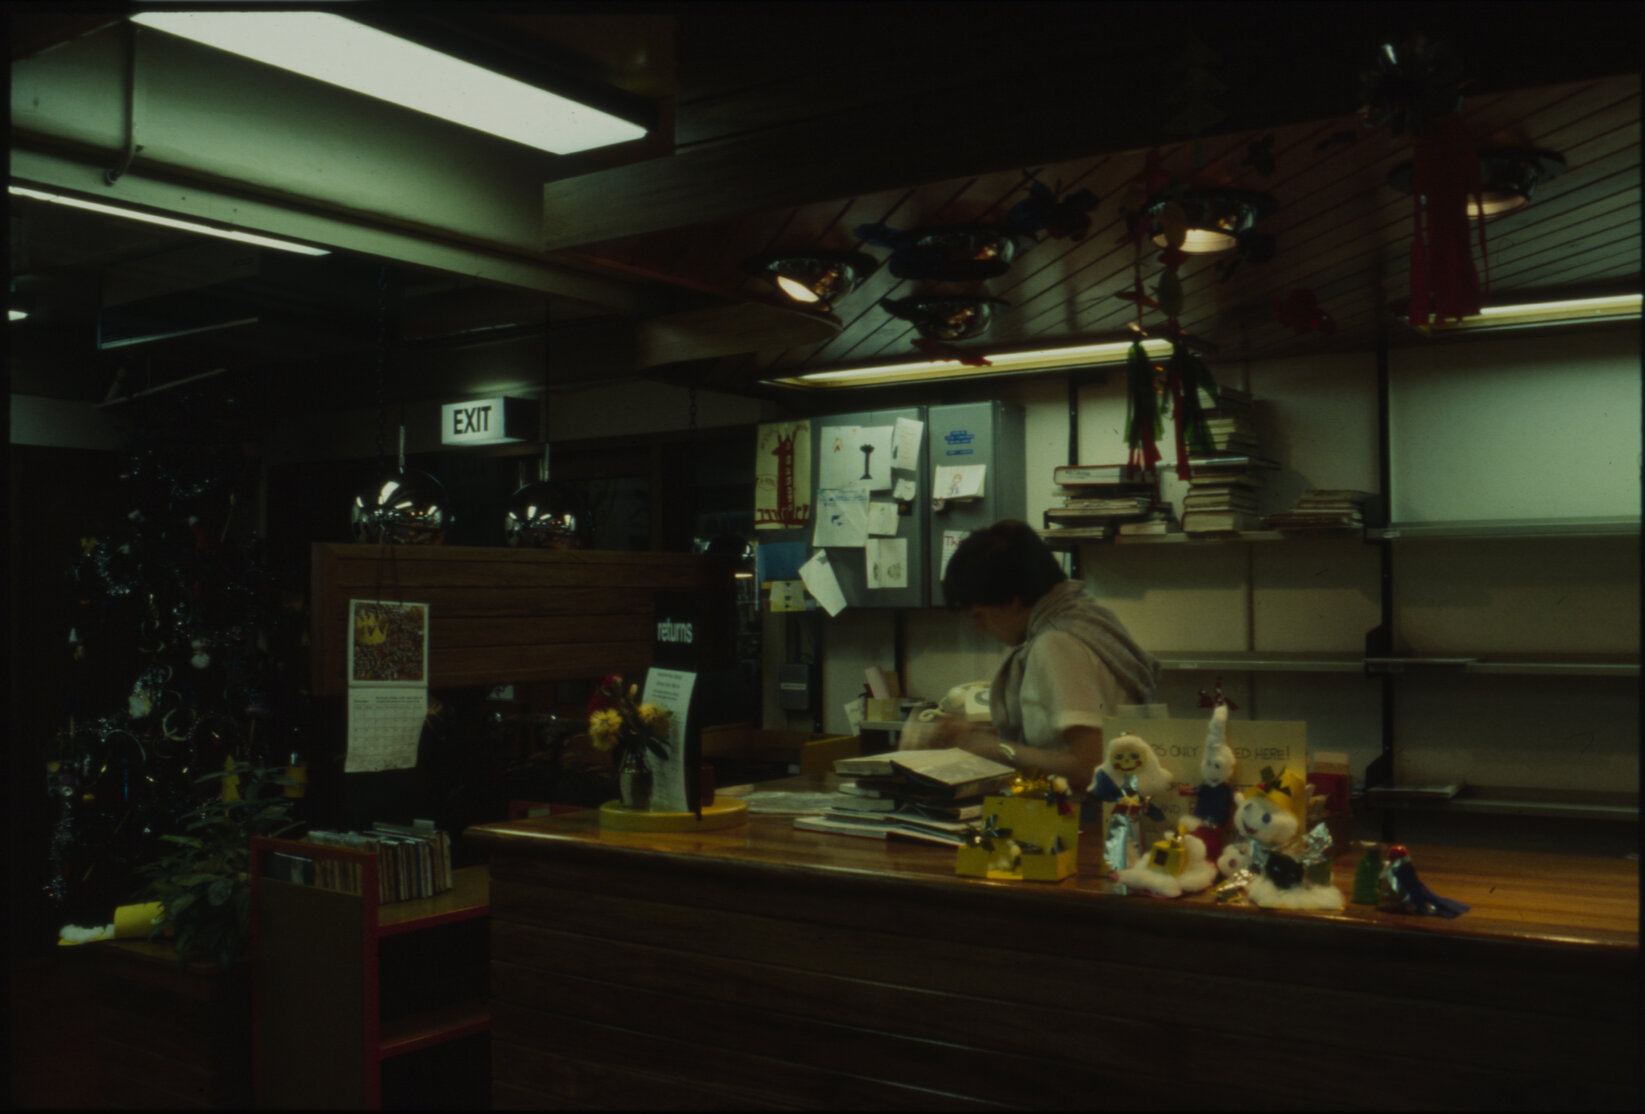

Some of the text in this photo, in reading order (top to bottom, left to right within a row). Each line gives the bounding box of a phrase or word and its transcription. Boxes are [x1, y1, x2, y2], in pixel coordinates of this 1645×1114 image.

[453, 405, 492, 435] EXIT
[658, 616, 693, 643] returns
[1169, 743, 1200, 758] ONLY
[1254, 745, 1291, 761] HERE!
